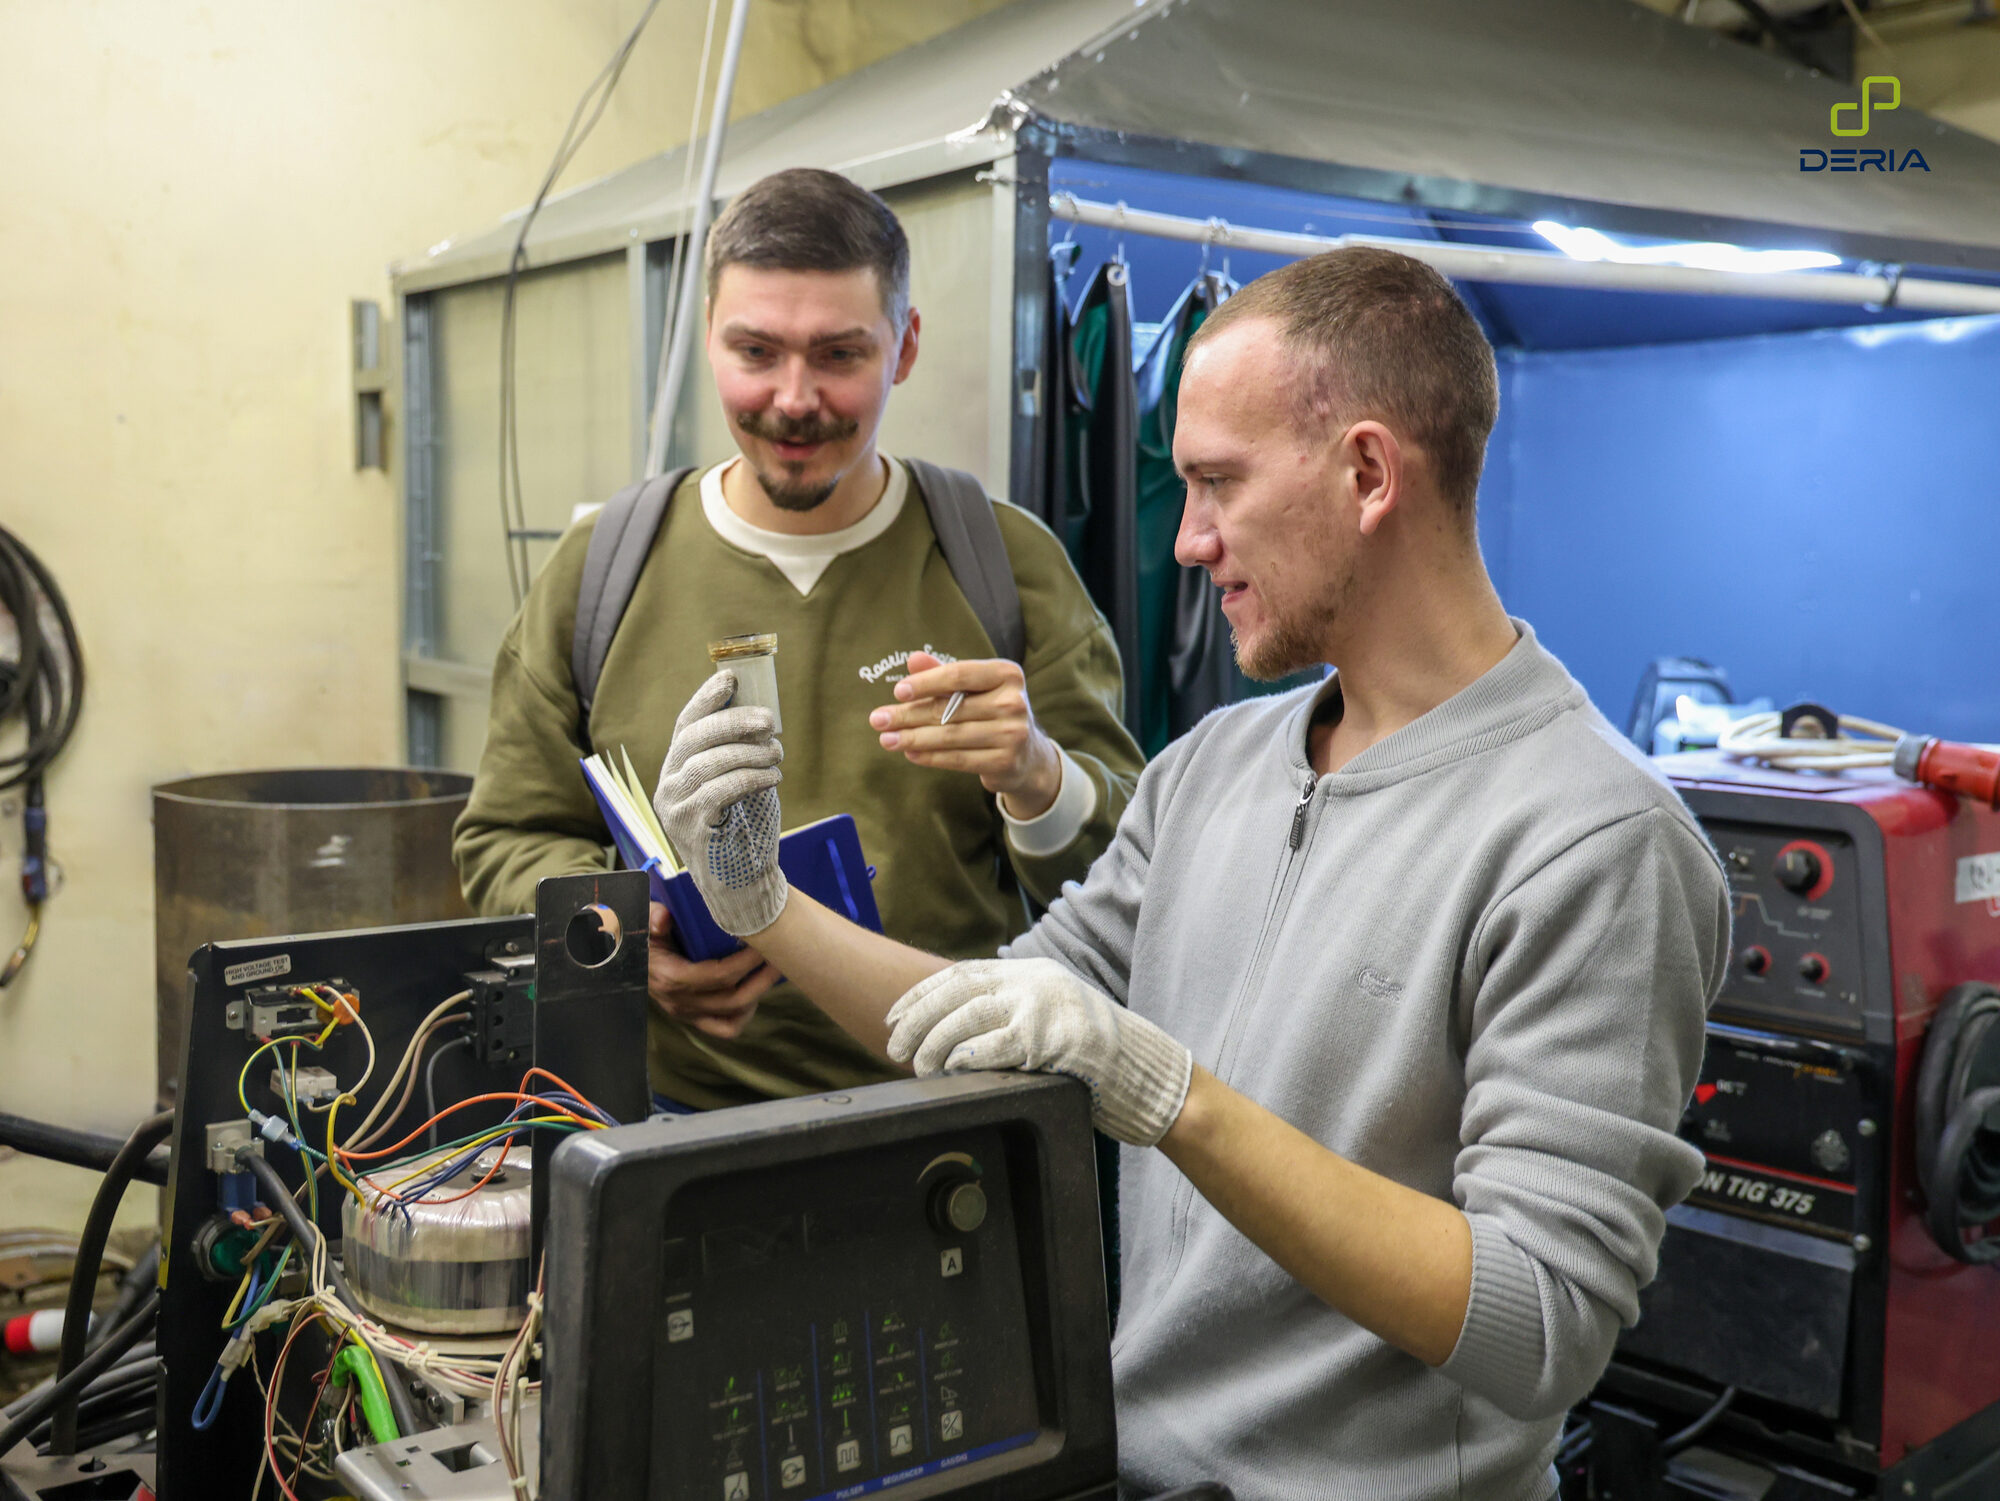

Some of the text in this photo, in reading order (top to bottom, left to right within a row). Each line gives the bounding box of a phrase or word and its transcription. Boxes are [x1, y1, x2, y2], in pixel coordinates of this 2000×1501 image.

[858, 650, 915, 684] Roarin
[225, 966, 242, 976] HIGH
[243, 960, 271, 973] VOLTAGE
[273, 957, 289, 966] TEST
[231, 972, 245, 981] AND
[246, 966, 274, 978] GROUND
[1700, 1170, 1816, 1215] N TIG 375
[946, 1256, 958, 1272] A
[882, 1466, 925, 1487] SEQUENCER
